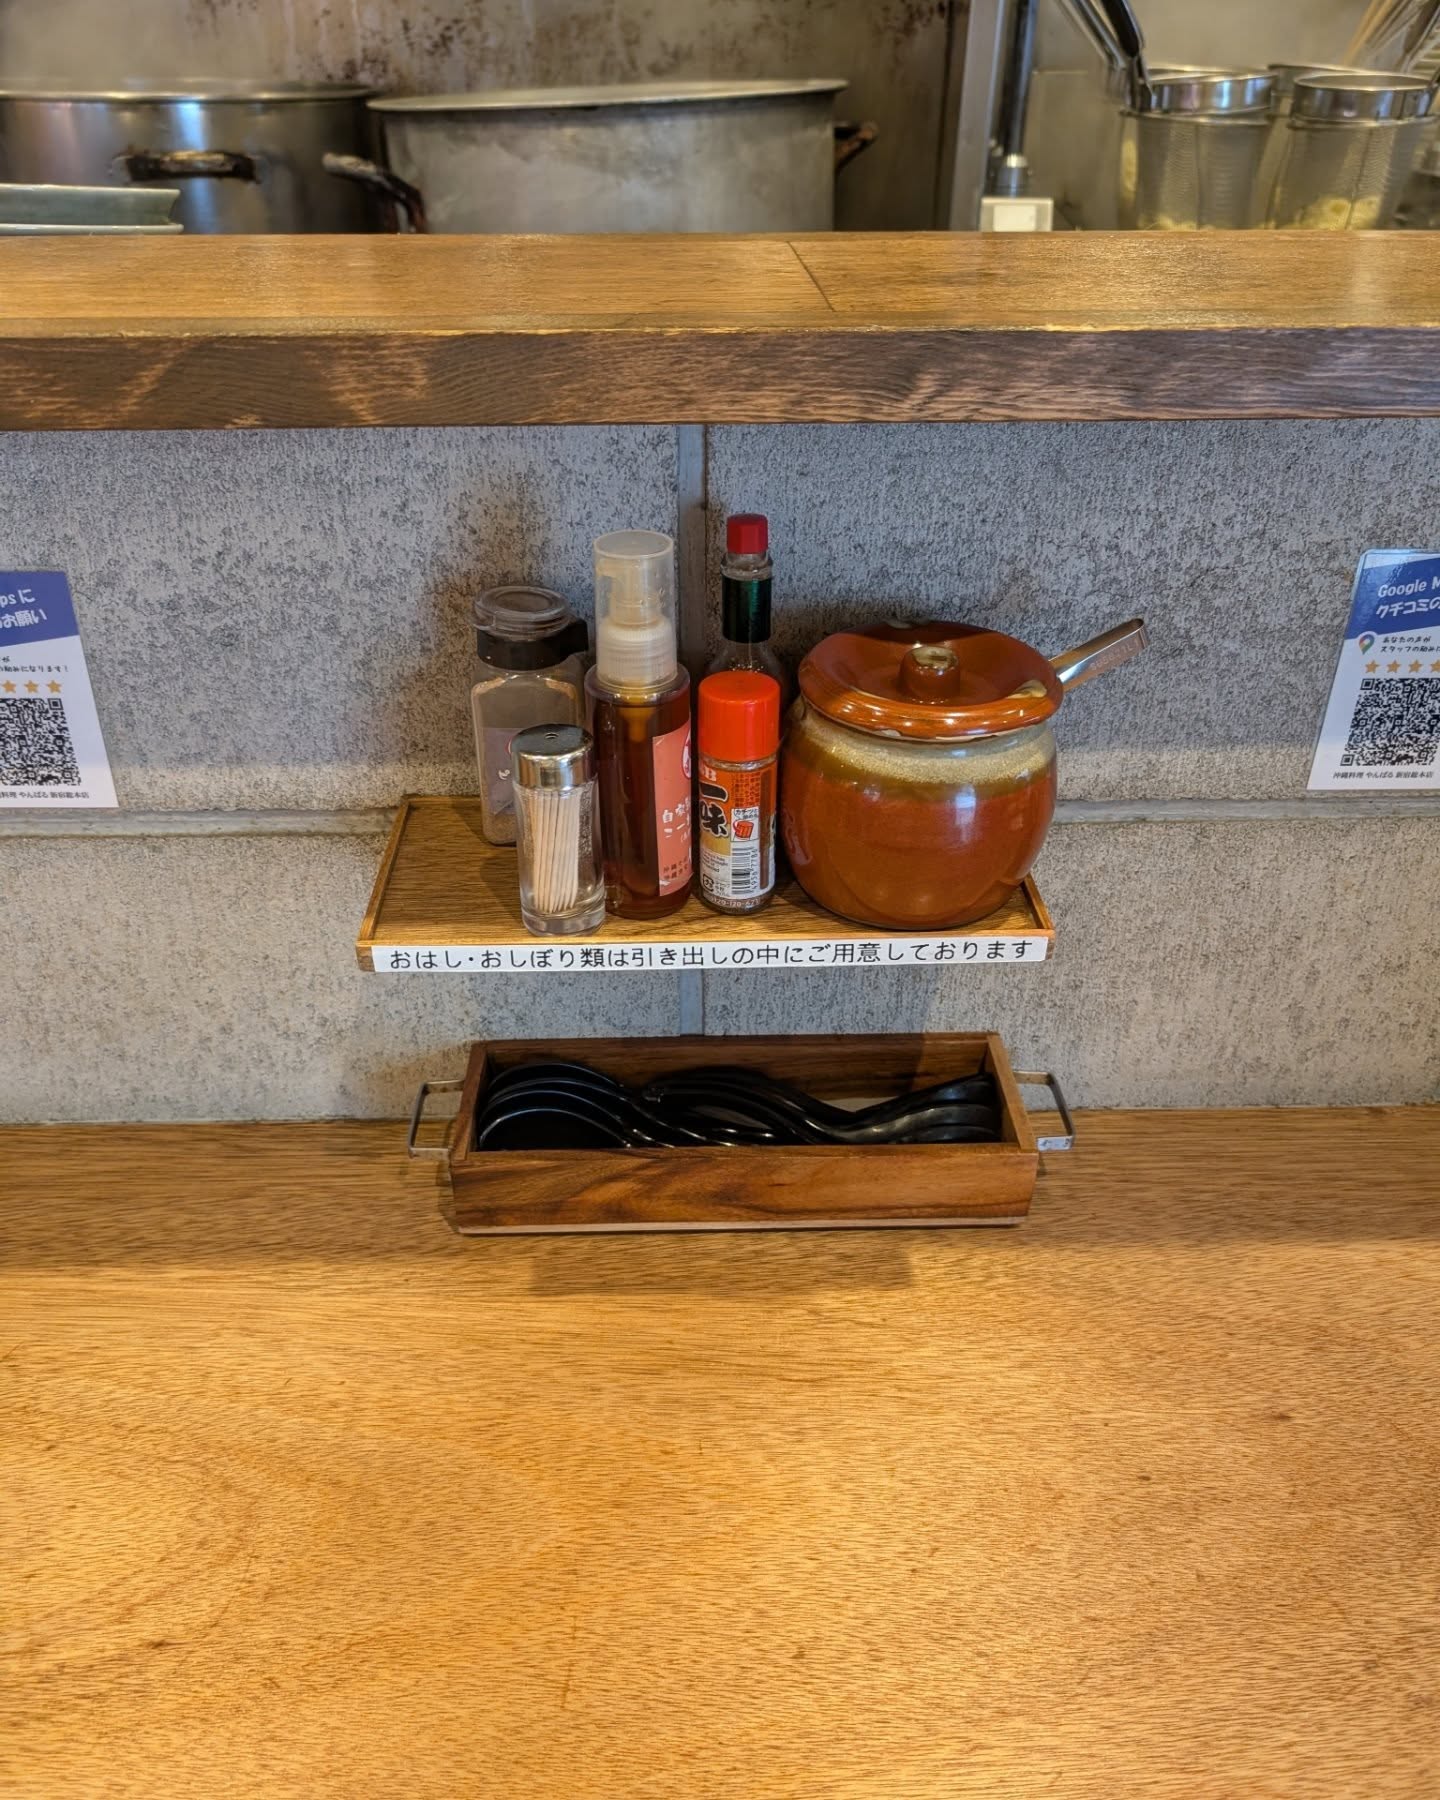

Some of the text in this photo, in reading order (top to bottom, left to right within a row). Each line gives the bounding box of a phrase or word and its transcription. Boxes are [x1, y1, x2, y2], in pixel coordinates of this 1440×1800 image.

[1377, 579, 1428, 598] Google
[0, 609, 47, 629] お願い
[390, 939, 1033, 969] おはし・おしぼり類は引き出しの中にご用意しております
